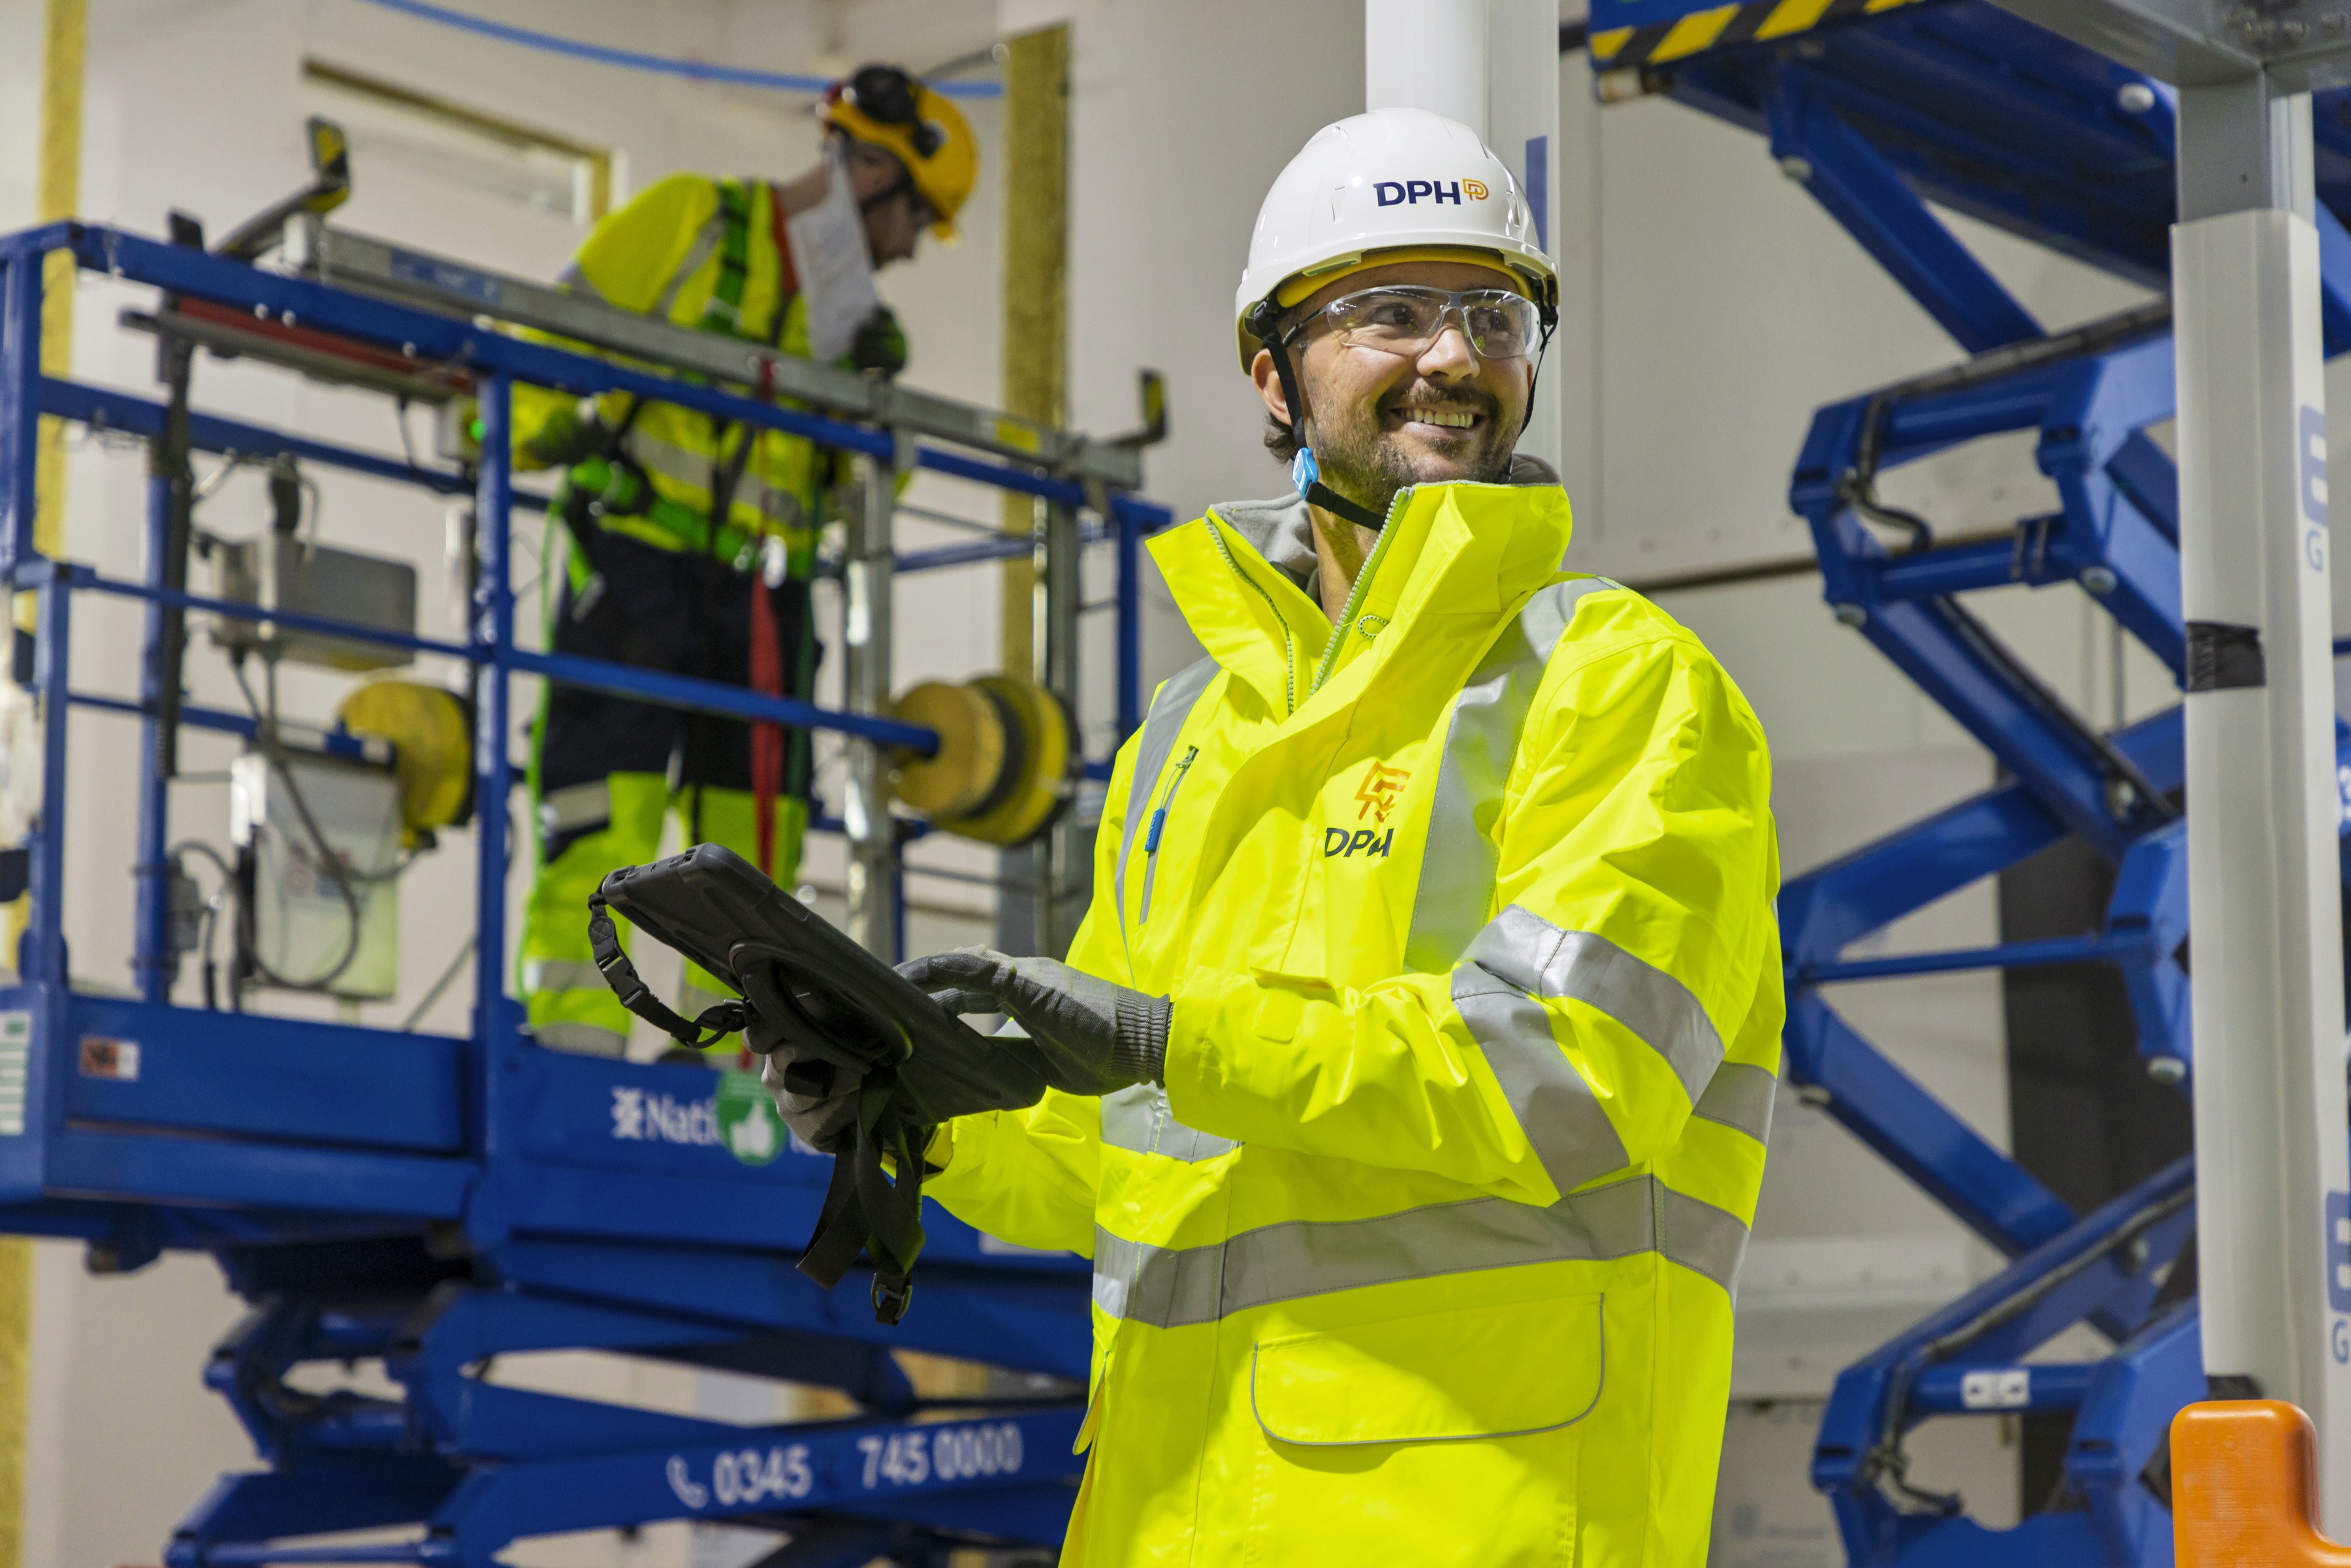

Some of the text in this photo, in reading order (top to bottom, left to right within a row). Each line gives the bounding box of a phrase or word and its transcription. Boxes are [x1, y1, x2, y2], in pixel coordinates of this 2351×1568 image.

[1373, 180, 1461, 206] DPH
[1324, 827, 1394, 857] DPH
[713, 1443, 813, 1505] 0345
